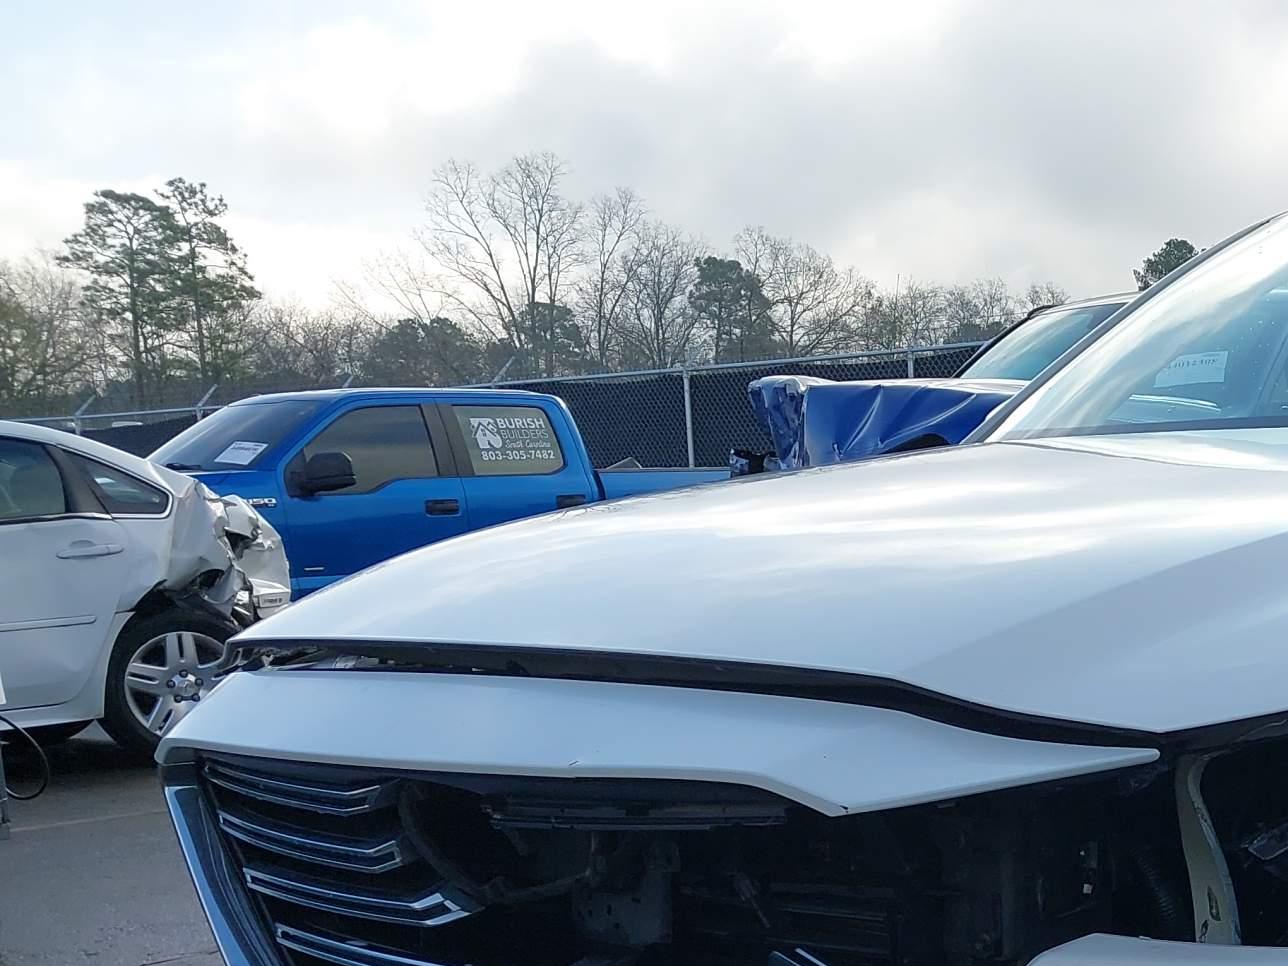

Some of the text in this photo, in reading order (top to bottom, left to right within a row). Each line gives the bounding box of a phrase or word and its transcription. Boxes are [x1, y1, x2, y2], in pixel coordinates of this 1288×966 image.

[496, 418, 545, 428] BURISH
[501, 430, 548, 438] BUILDERS
[481, 450, 555, 460] 803-305-7482
